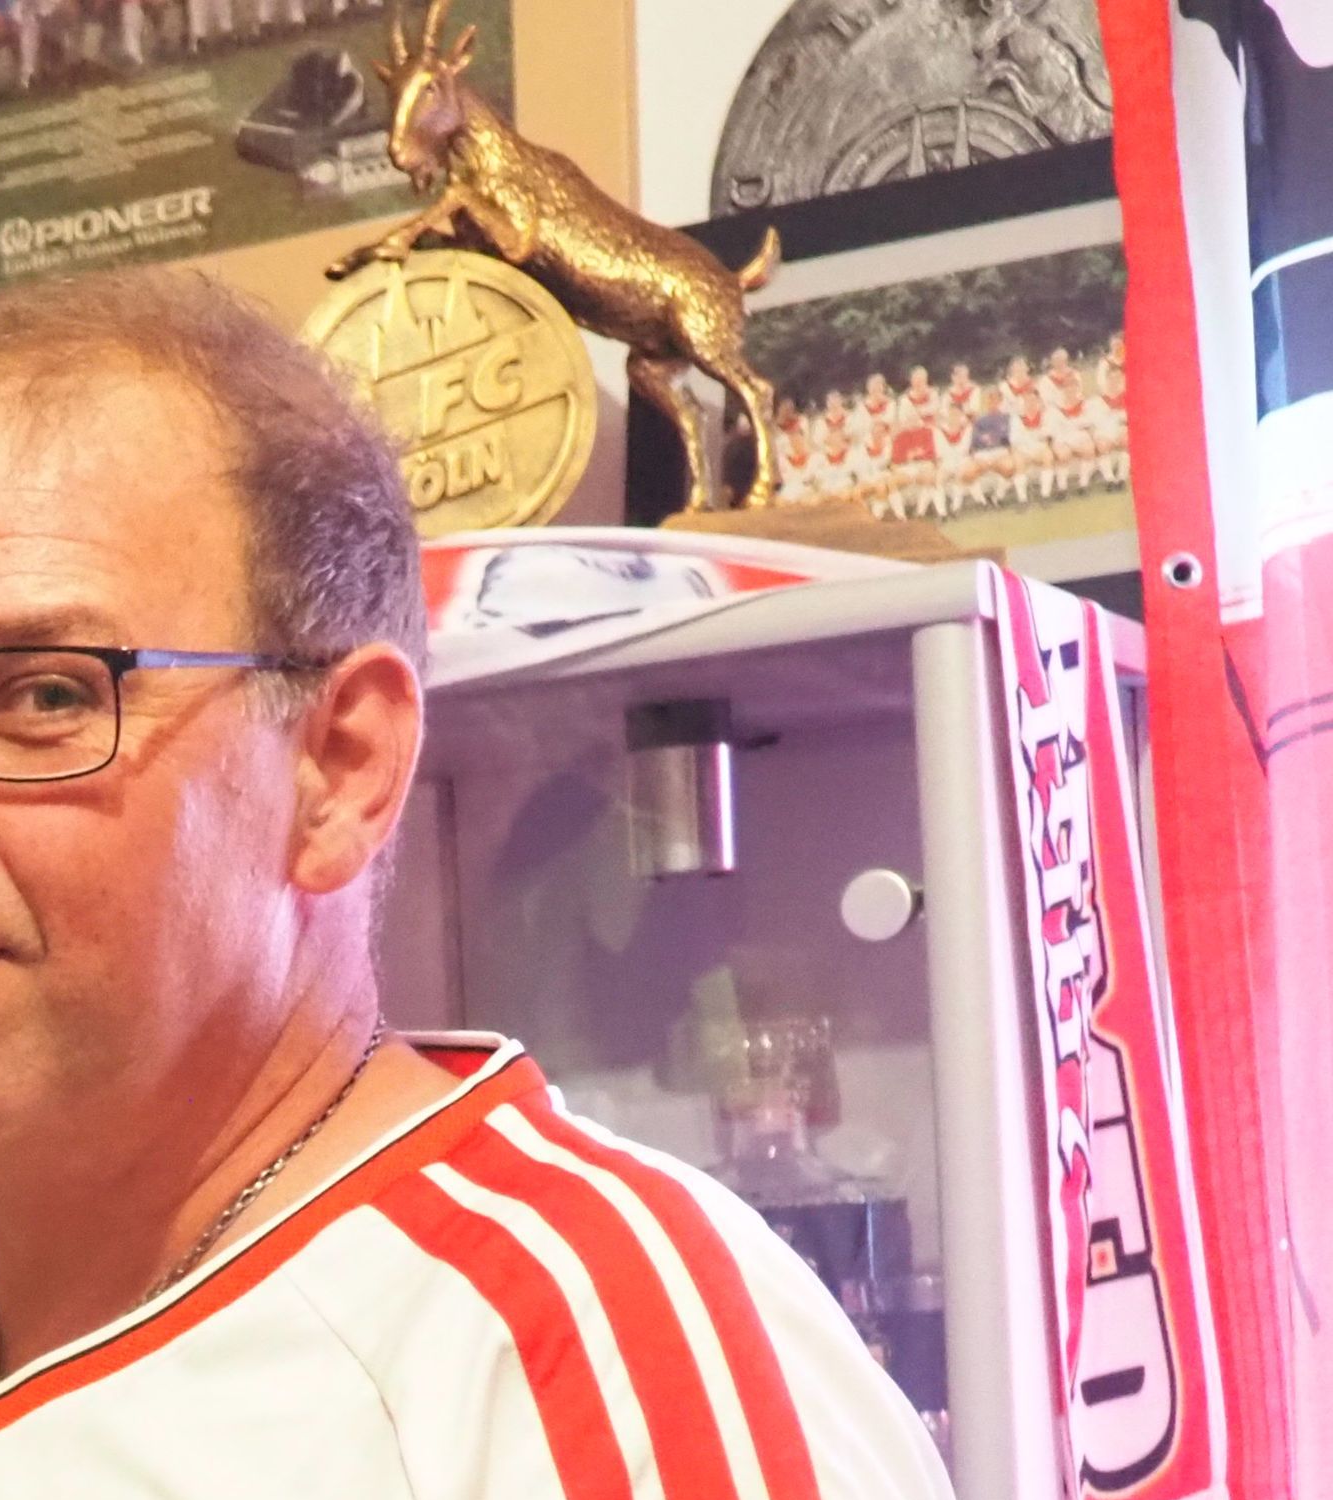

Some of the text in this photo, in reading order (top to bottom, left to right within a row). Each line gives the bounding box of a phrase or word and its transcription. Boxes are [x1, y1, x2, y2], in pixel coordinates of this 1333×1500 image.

[34, 186, 214, 250] PIONEER
[419, 336, 526, 442] FC
[400, 438, 505, 511] ÖLN
